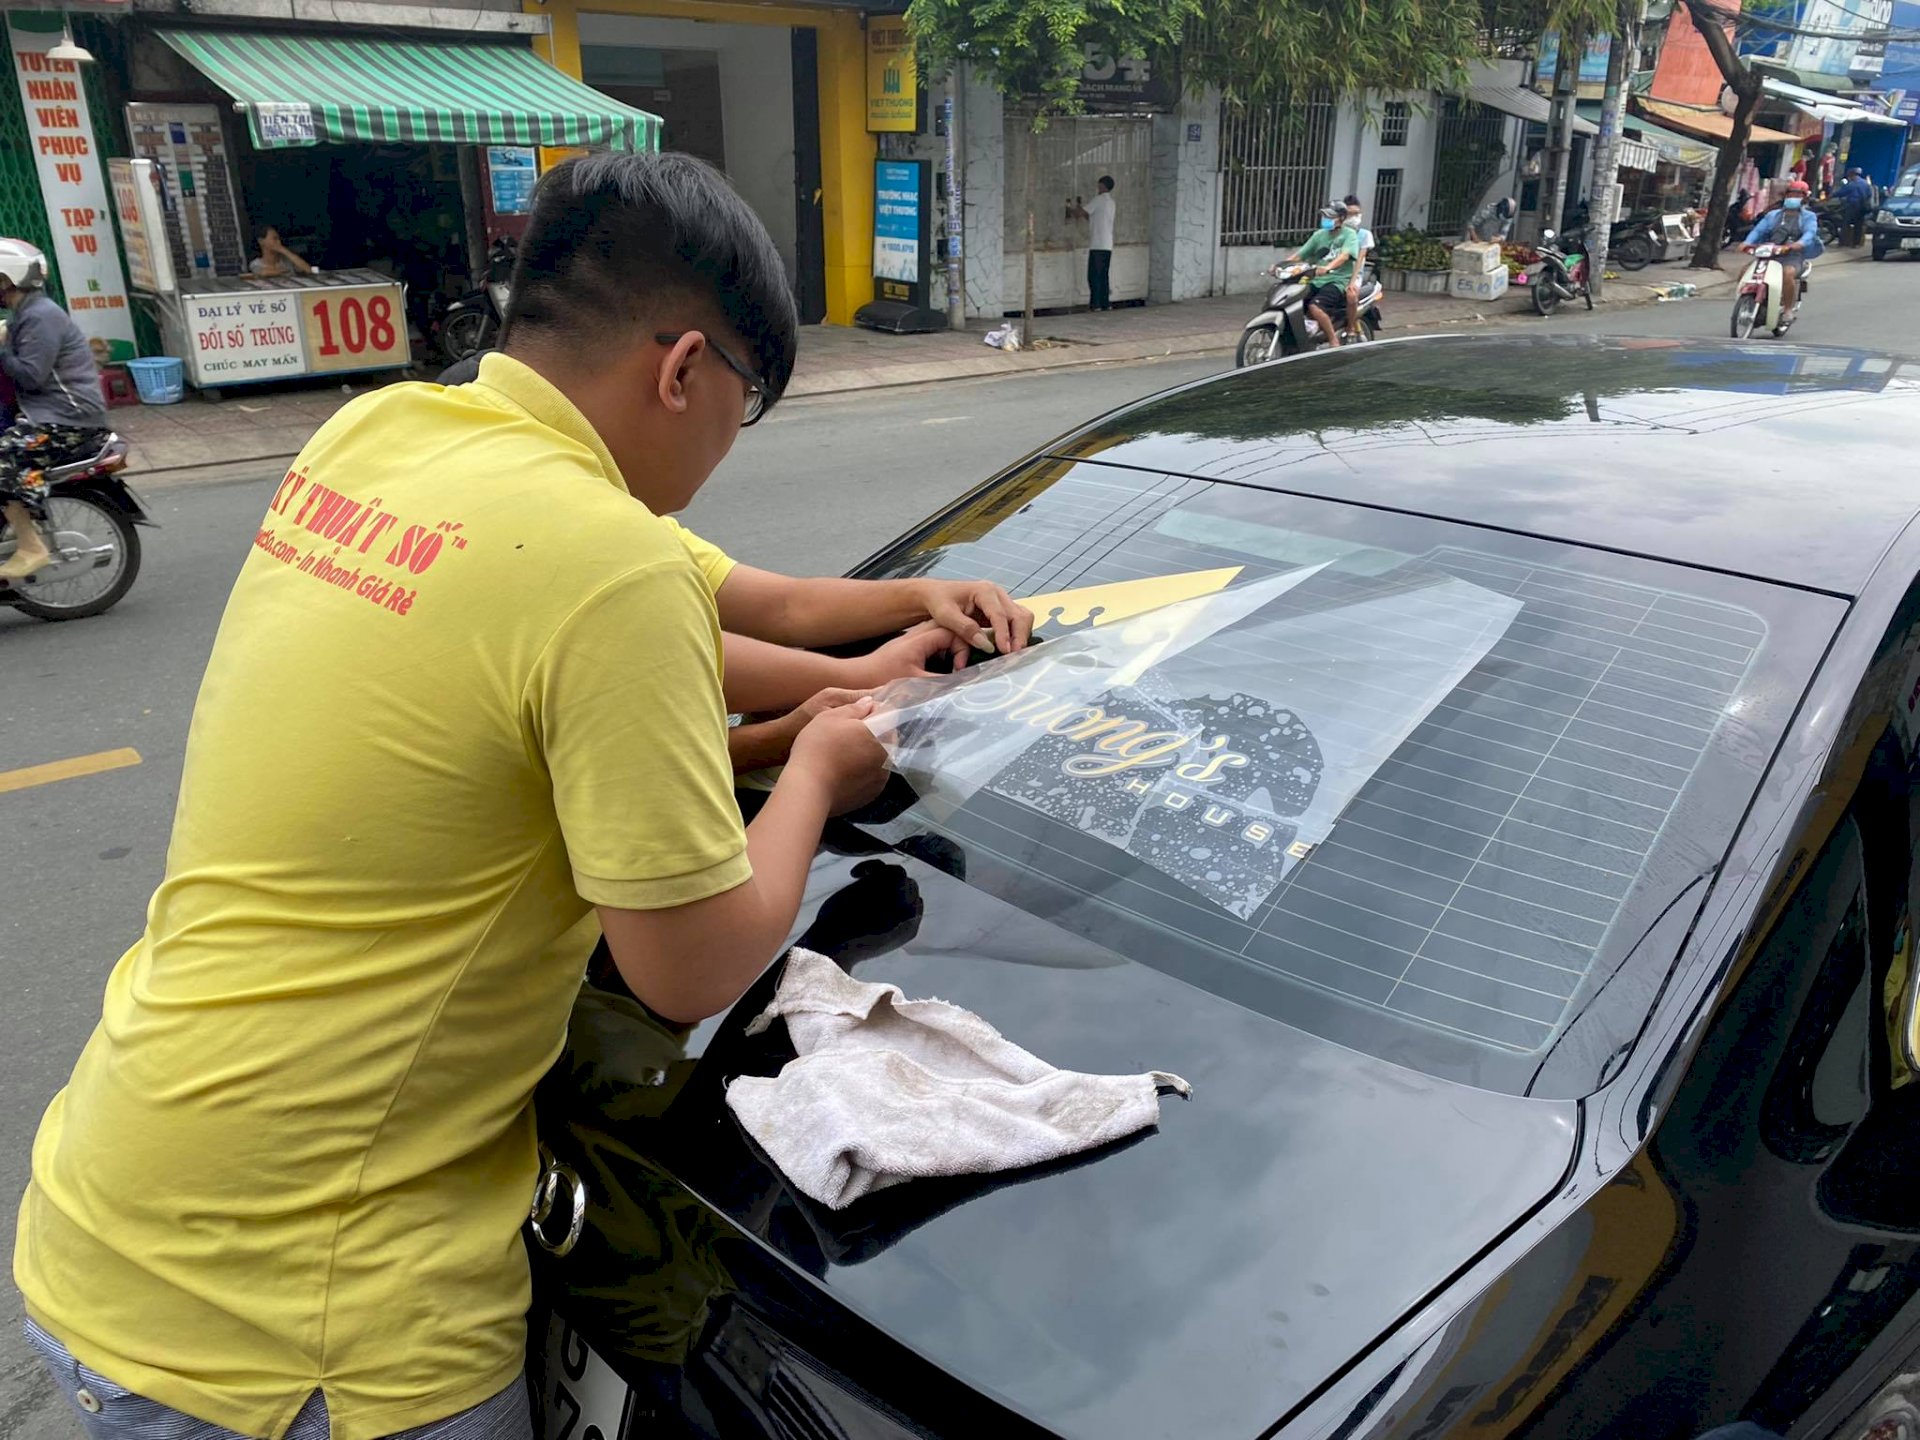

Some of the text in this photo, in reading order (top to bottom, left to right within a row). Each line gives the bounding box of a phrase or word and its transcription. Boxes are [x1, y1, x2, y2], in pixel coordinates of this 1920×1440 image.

[26, 77, 78, 100] NHÂN
[35, 105, 80, 128] VIÊN
[38, 135, 89, 159] PHỤC
[55, 163, 82, 186] VỤ
[61, 208, 95, 230] TẠP
[71, 234, 97, 257] VỤ
[198, 306, 222, 320] ĐẠI
[226, 301, 242, 316] LÝ
[271, 298, 287, 313] SỐ
[198, 321, 295, 350] ĐỔI SỐ TRÚNG
[313, 295, 396, 356] 108
[203, 360, 238, 372] CHÚC
[242, 358, 268, 369] MAY
[293, 483, 399, 555] THUẬT
[297, 550, 316, 574] In
[309, 554, 361, 591] Nhanh
[356, 575, 393, 605] Giá
[384, 586, 417, 616] Rẻ
[1126, 778, 1312, 858] HOUSE
